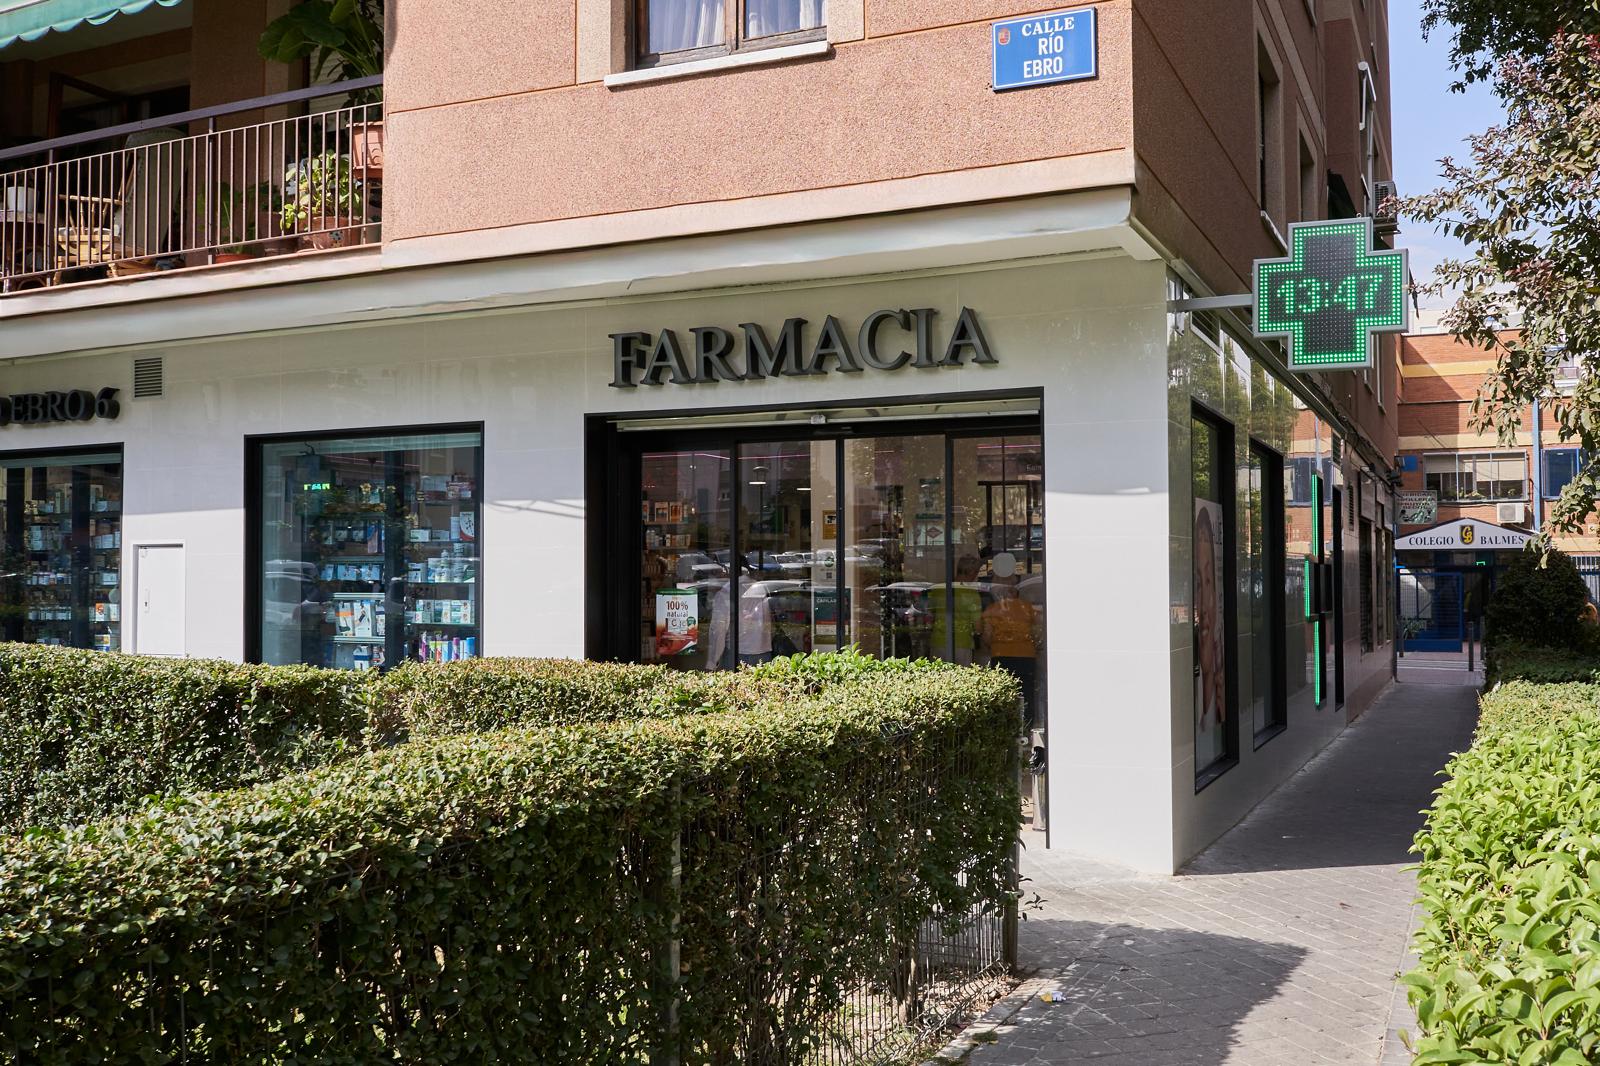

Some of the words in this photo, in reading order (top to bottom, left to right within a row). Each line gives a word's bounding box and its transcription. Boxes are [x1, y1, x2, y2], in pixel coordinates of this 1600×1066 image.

[1021, 16, 1075, 37] CALLE
[1038, 32, 1064, 56] RÍO
[1023, 56, 1063, 79] EBRO
[1276, 274, 1384, 315] 13:47
[607, 305, 999, 389] FARMACIA
[9, 389, 96, 424] EBRO
[95, 387, 121, 419] 6
[1408, 536, 1454, 546] COLEGIO
[1480, 535, 1525, 545] BALMES
[666, 600, 689, 611] 100%
